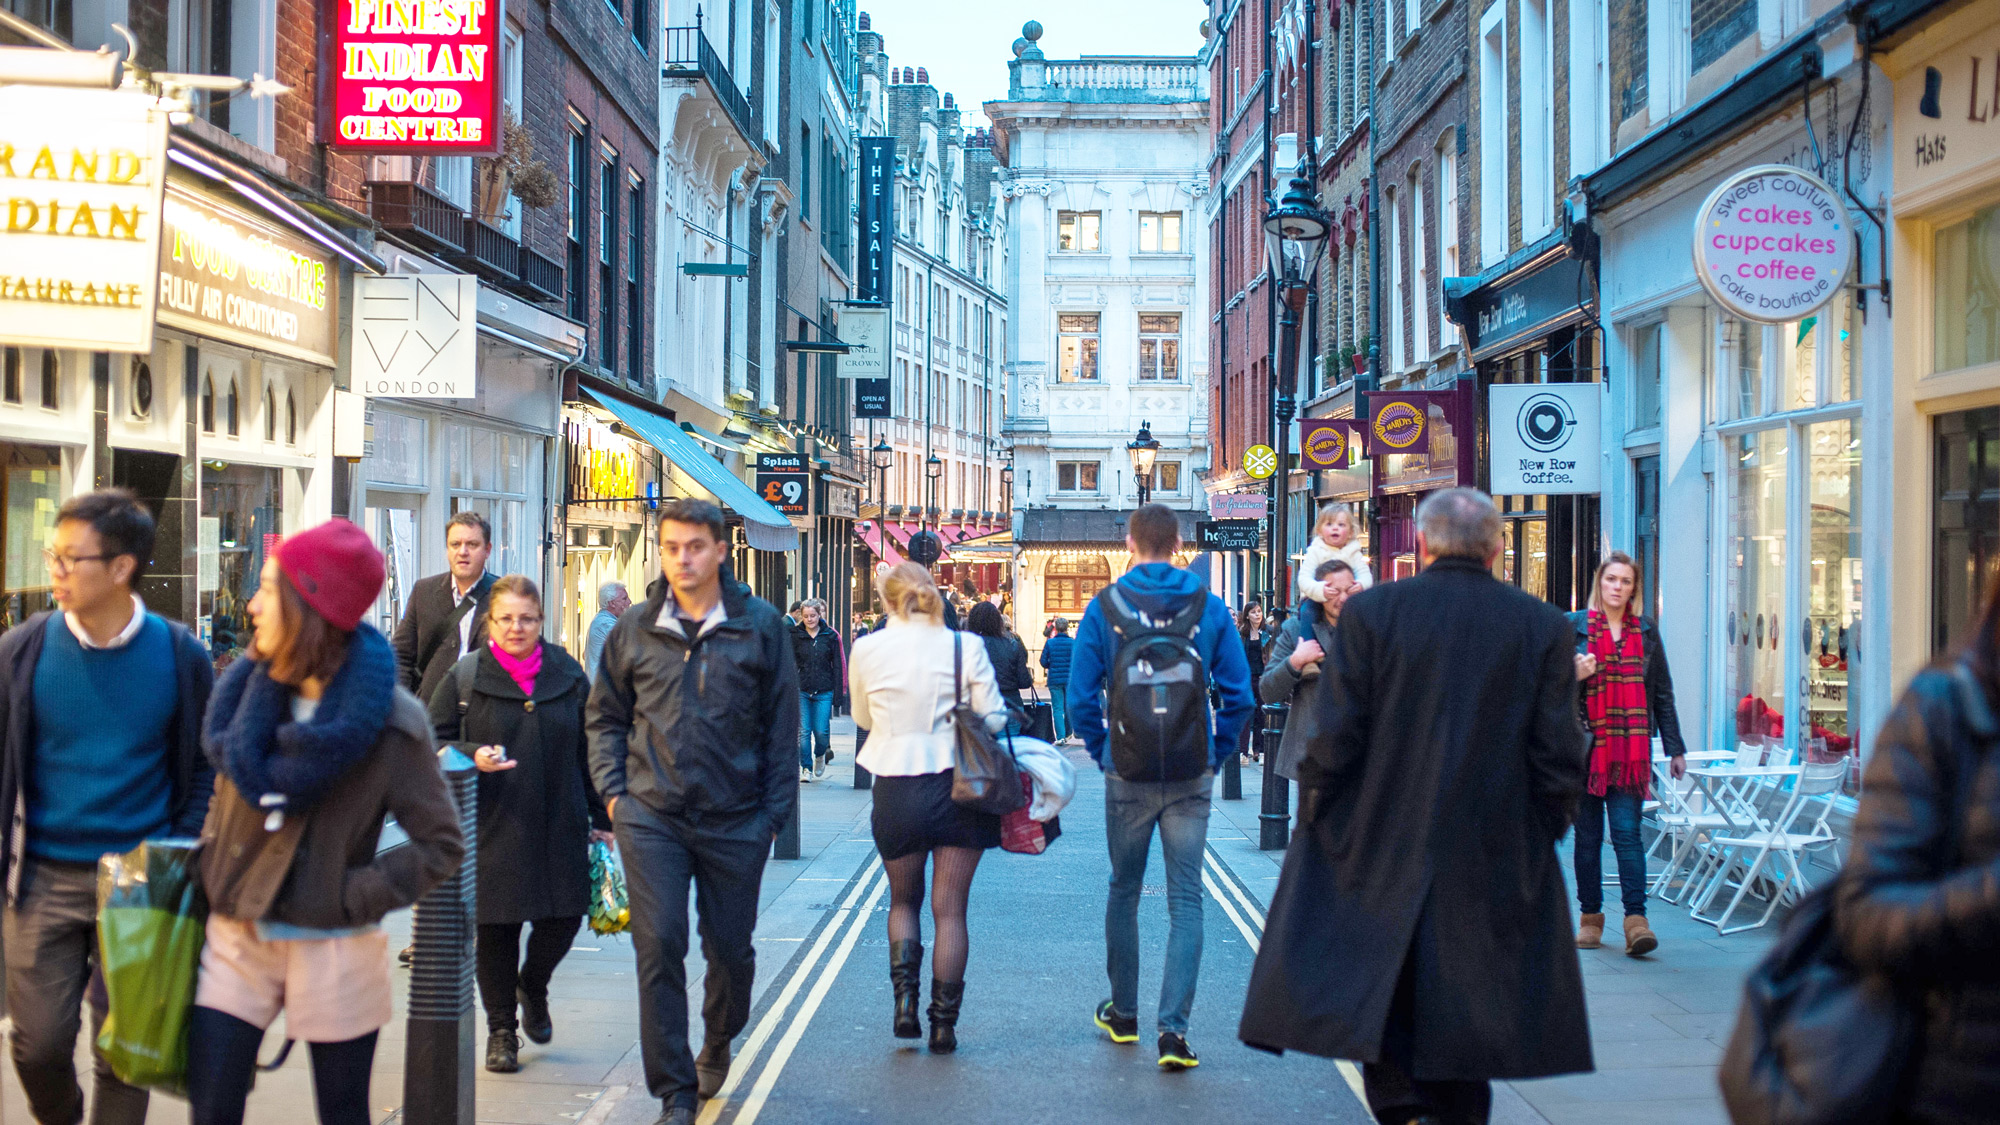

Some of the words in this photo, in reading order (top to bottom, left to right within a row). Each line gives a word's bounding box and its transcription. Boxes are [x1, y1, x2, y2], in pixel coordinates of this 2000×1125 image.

[347, 0, 486, 35] FINEST
[342, 42, 488, 82] INDIAN
[362, 87, 462, 113] FOOD
[339, 115, 482, 142] CENTRE
[1916, 133, 1946, 168] Hats
[871, 146, 882, 196] THE
[1717, 176, 1765, 218] sweet
[1772, 177, 1835, 221] couture
[1737, 204, 1813, 226] cakes
[1712, 233, 1836, 255] cupcakes
[1737, 259, 1816, 280] coffee
[1719, 273, 1755, 304] cake
[1759, 278, 1829, 309] boutique
[160, 271, 199, 313] FULLY
[201, 286, 223, 321] AIR
[225, 293, 298, 342] CONDITIONED
[365, 380, 455, 394] LONDON
[762, 457, 800, 467] Splash
[1519, 458, 1546, 470] New
[1550, 458, 1576, 470] Row
[1522, 472, 1573, 484] Coffee.
[763, 481, 802, 504] £9
